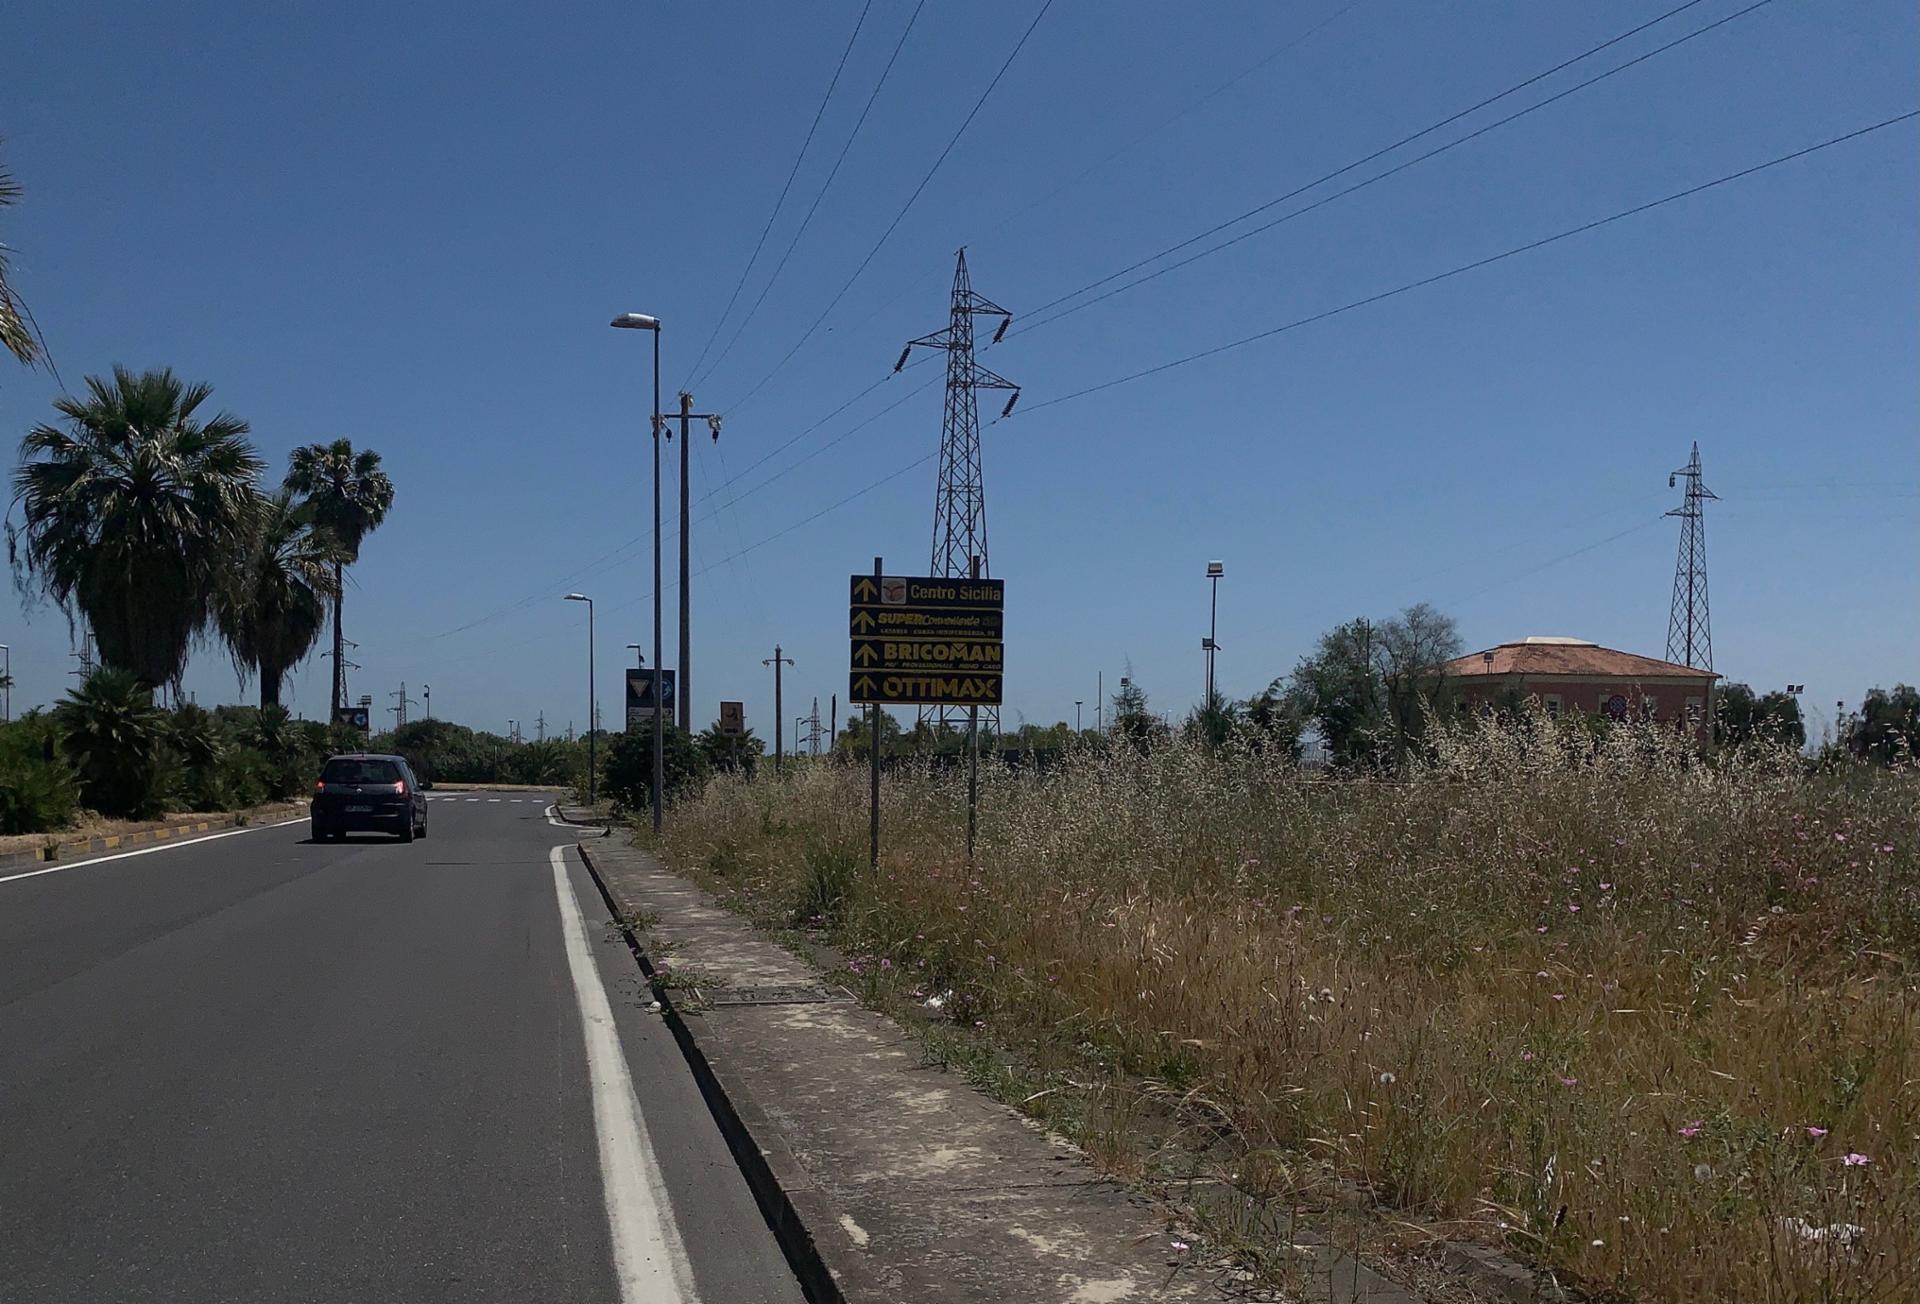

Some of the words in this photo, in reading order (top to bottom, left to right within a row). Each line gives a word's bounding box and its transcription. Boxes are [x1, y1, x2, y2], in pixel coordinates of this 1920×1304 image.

[910, 584, 956, 600] Centro
[959, 585, 1001, 601] Sicilia
[883, 642, 1001, 662] BRICOMAN
[882, 676, 997, 698] OTTIMAX
